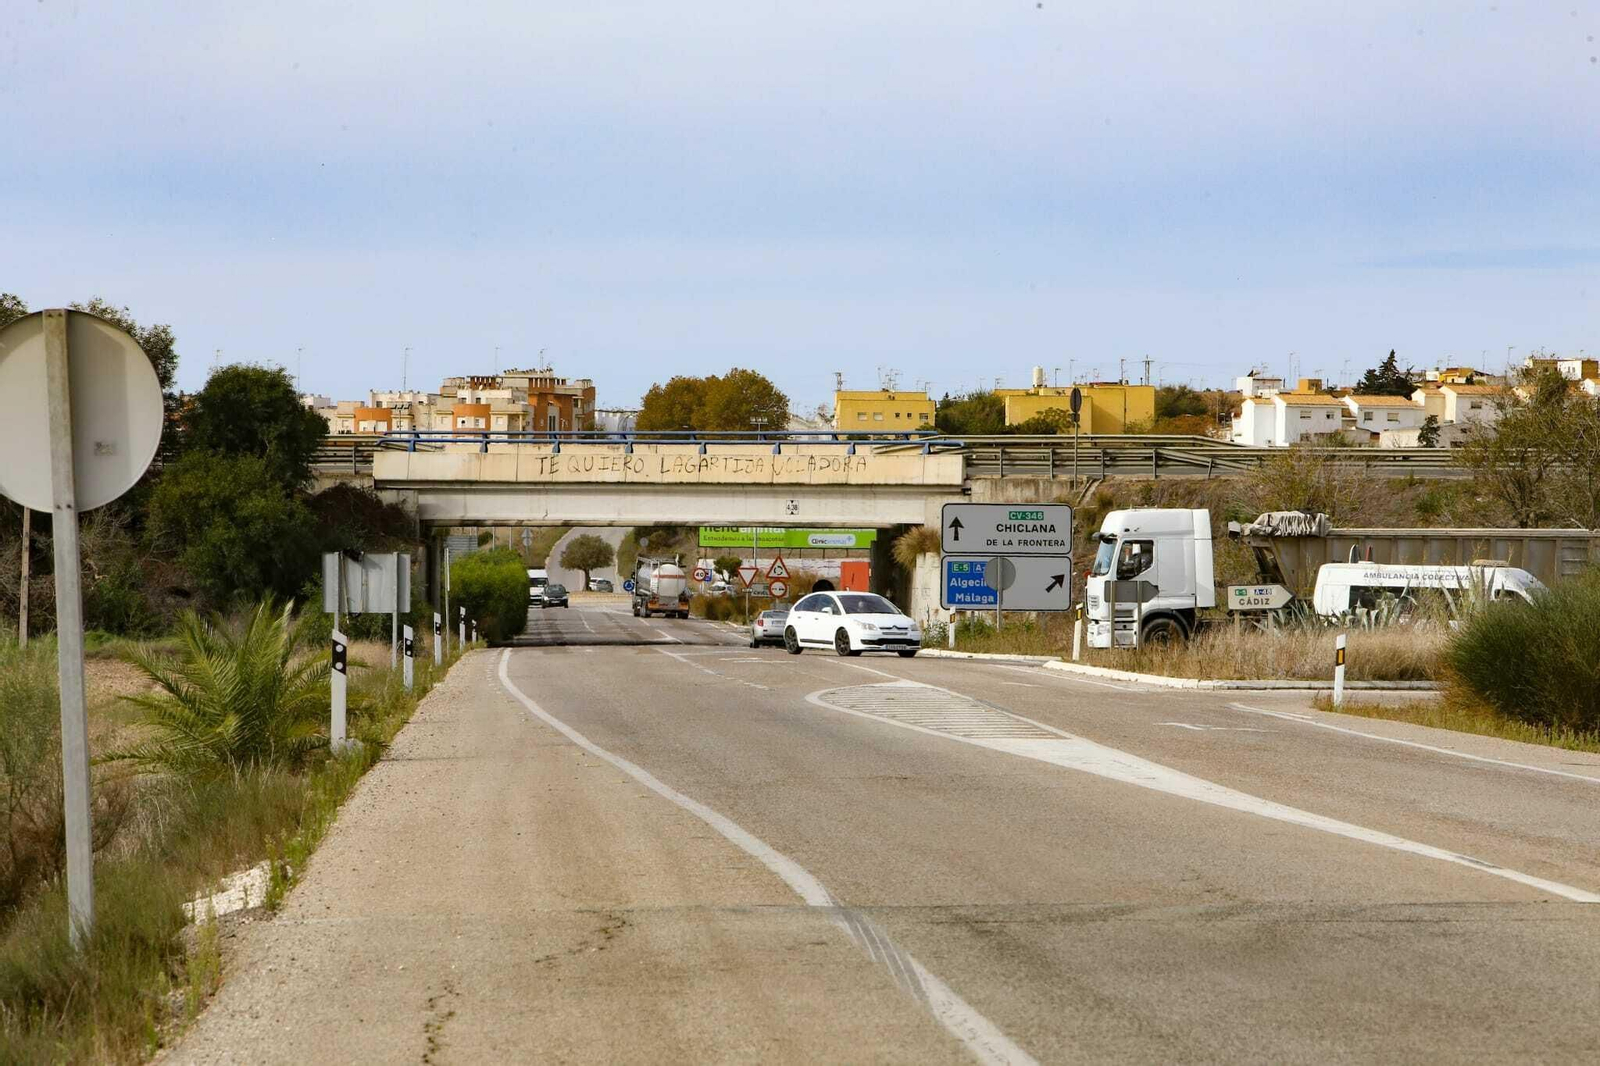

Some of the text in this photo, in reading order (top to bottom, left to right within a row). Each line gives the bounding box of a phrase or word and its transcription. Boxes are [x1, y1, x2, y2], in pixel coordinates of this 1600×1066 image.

[535, 456, 560, 475] TE
[660, 455, 764, 474] LAGARTIJA
[1010, 511, 1043, 520] CV-346
[996, 523, 1056, 533] CHICLANA
[1018, 539, 1066, 547] FRONTERA
[953, 563, 969, 571] E-5
[1363, 572, 1470, 581] AMBULANCIA COLECTIVA
[955, 593, 995, 604] Málaga
[1238, 596, 1270, 606] CÁDIZ
